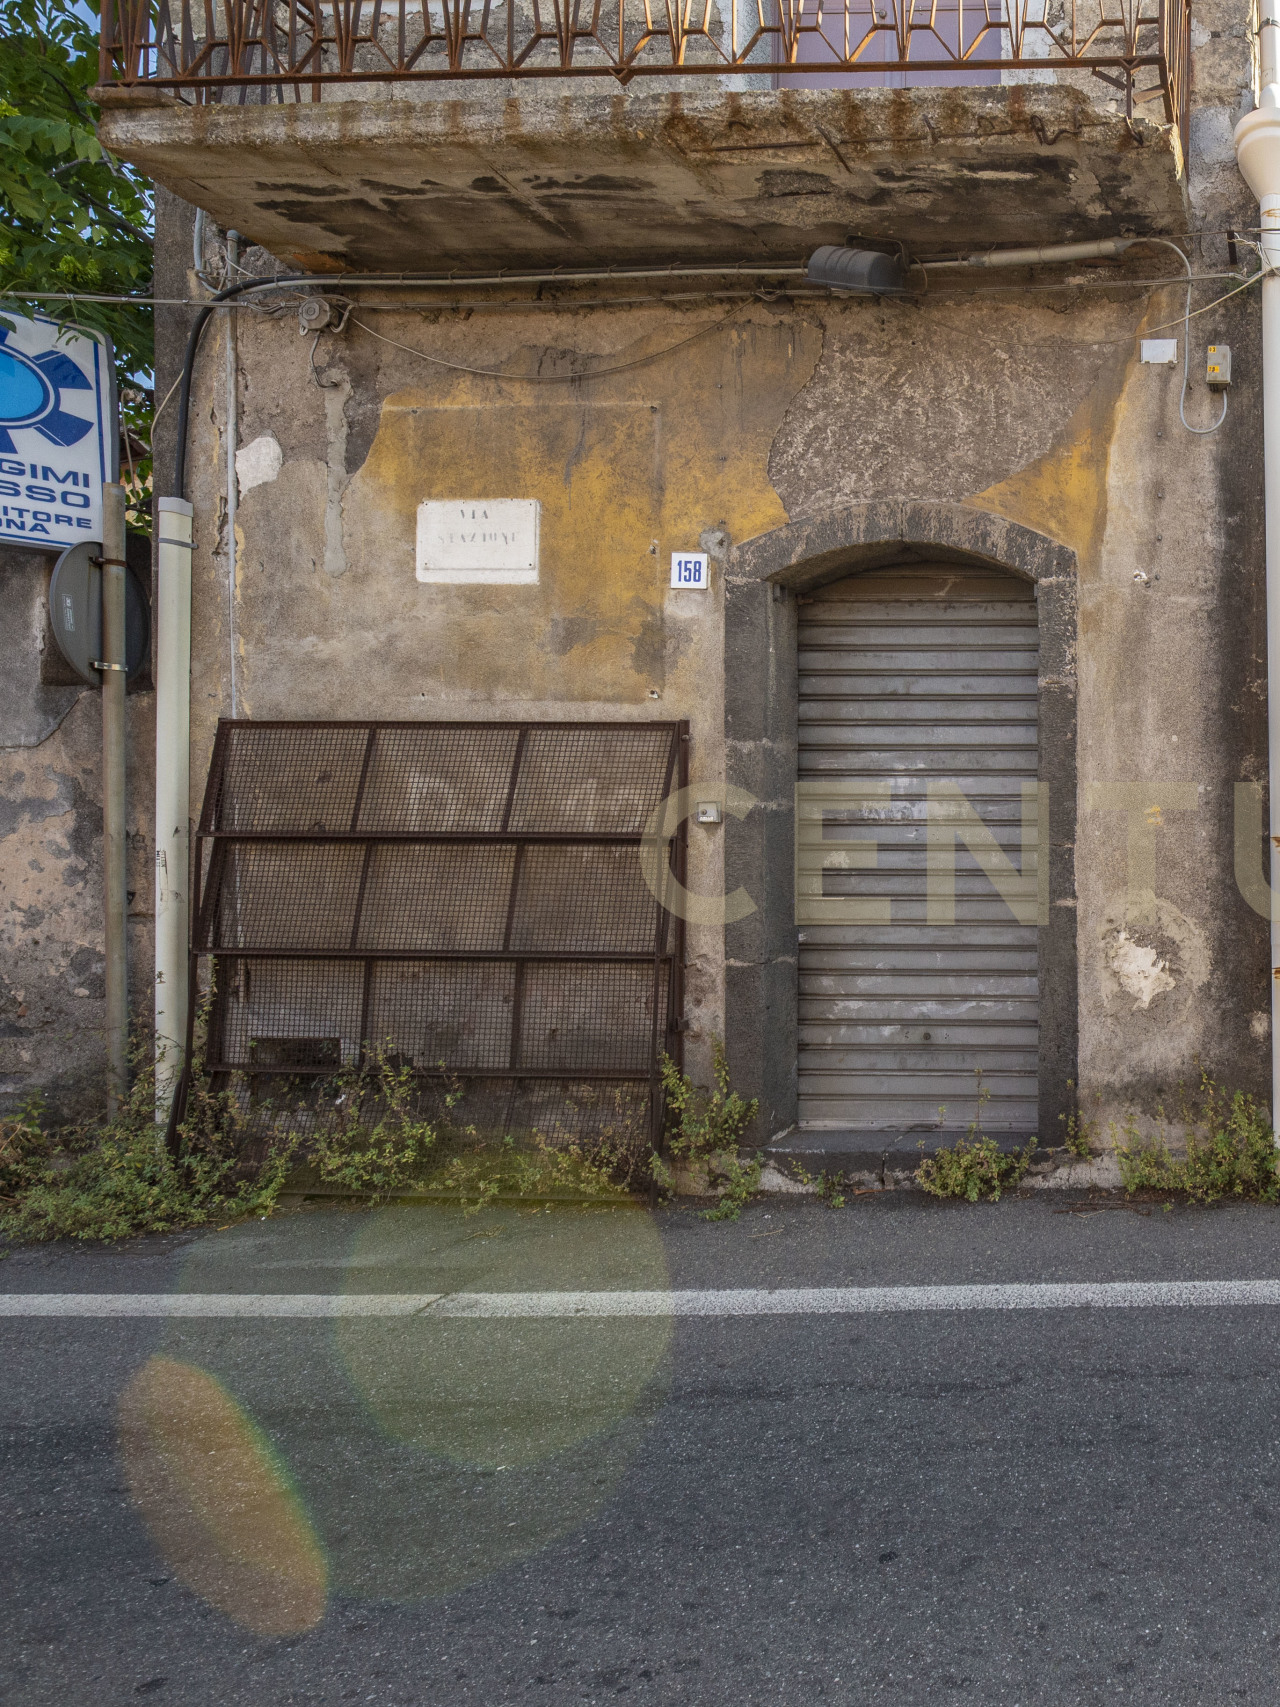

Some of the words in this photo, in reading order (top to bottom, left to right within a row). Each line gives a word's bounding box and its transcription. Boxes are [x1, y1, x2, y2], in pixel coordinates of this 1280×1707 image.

[0, 458, 90, 488] GIMI
[0, 517, 51, 535] NA
[2, 505, 93, 530] ITORE
[677, 560, 702, 583] 158
